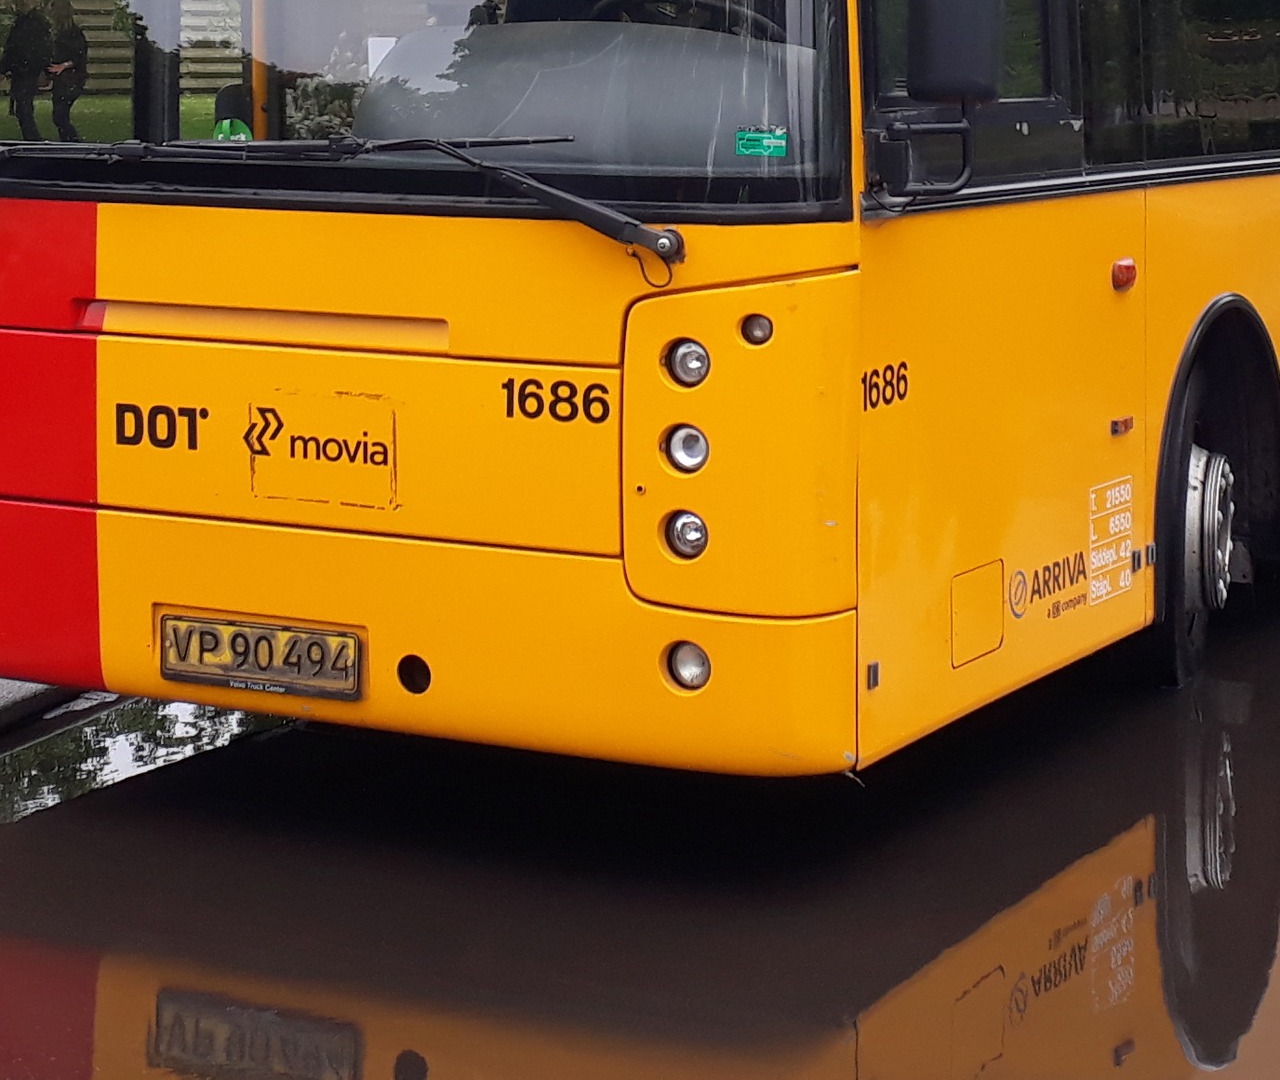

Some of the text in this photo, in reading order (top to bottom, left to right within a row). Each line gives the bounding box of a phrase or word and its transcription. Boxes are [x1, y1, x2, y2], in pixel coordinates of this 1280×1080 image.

[501, 378, 611, 424] 1686
[861, 361, 909, 412] 1686
[290, 431, 388, 466] movia
[1120, 539, 1131, 558] 42
[1030, 551, 1087, 603] ARRIVA
[1119, 569, 1131, 588] 40
[173, 628, 352, 680] VP 90 494
